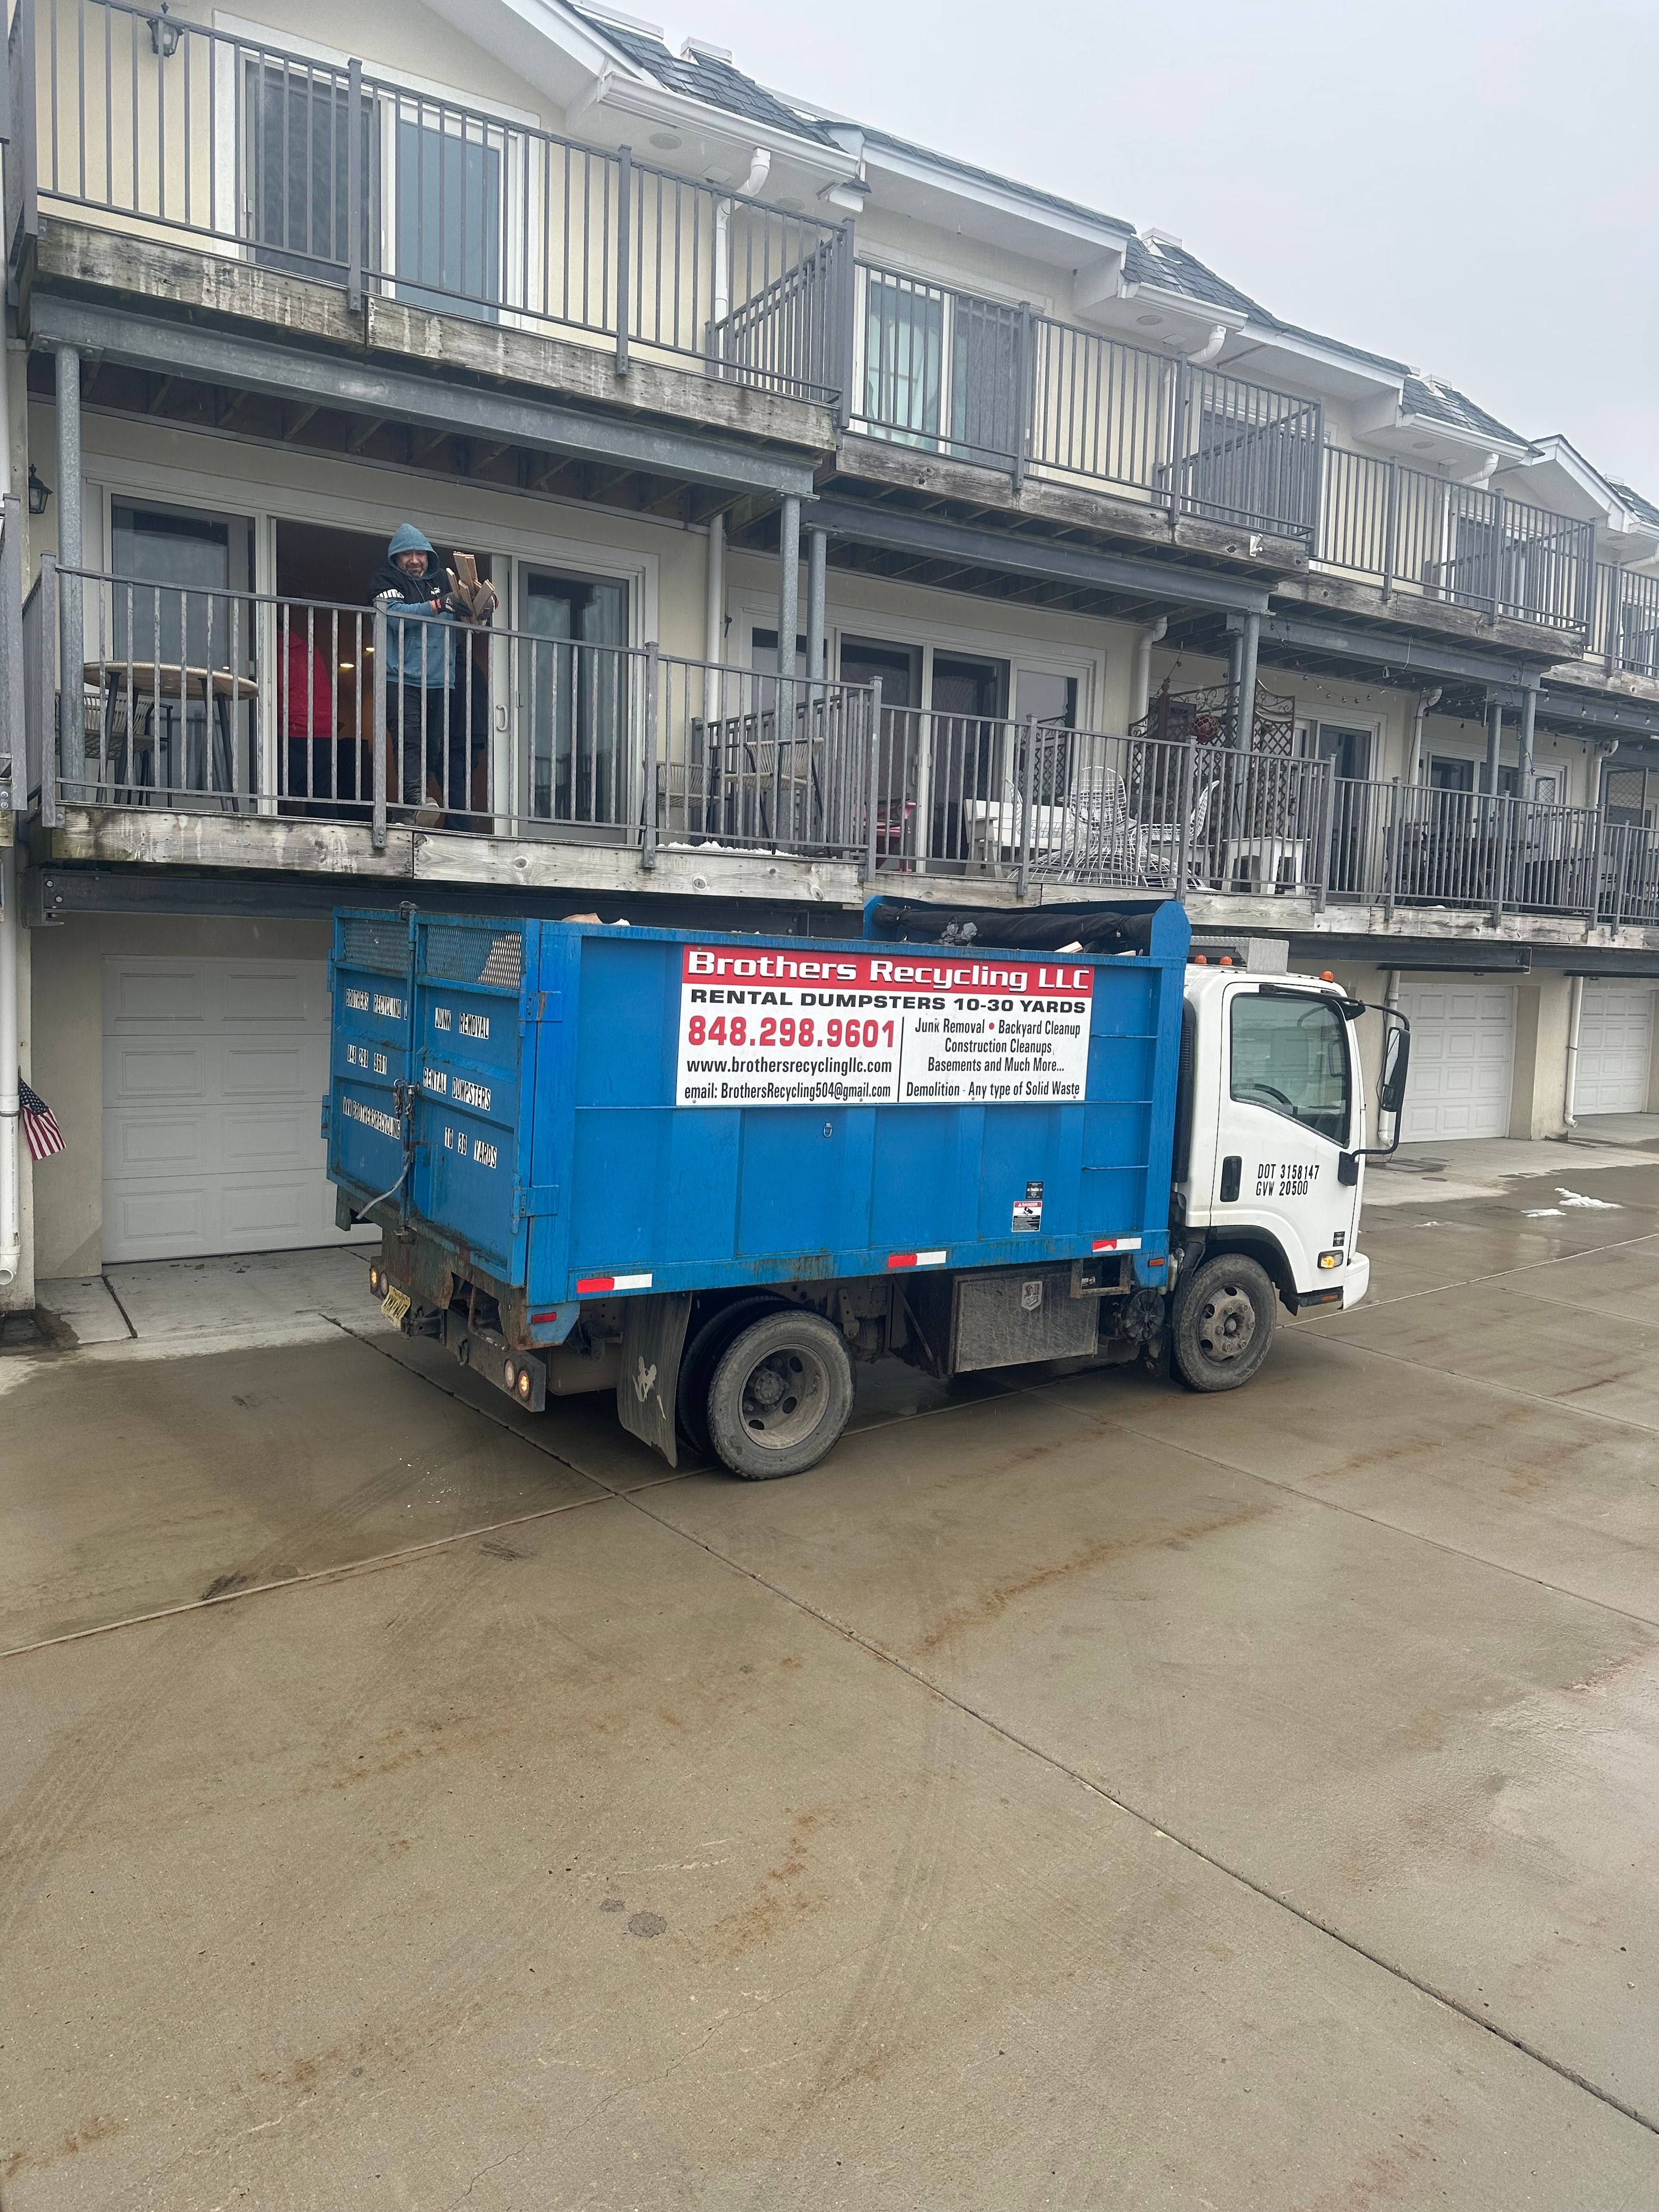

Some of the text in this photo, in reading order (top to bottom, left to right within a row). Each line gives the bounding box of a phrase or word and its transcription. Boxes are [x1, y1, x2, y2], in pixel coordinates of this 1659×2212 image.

[688, 951, 1090, 992] Brothers Recycling LLC
[346, 989, 369, 1011] BROTHERS
[691, 989, 1086, 1014] RENTAL DUMPSTERS 10-30 YARDS
[436, 1008, 489, 1039] JUNK REMOVAL
[688, 1015, 894, 1048] 848.298.9601
[915, 1018, 1081, 1039] Junk Removal Backyard Cleanup
[945, 1037, 1006, 1053] Construction
[348, 1045, 387, 1074] 848 298 9601
[687, 1057, 892, 1076] www.brothersrecyclingllc.com
[928, 1057, 1065, 1072] Basements and Much More...
[424, 1067, 491, 1110] RENTAL DUMPSTERS
[685, 1082, 891, 1102] email: BrothersRecycling504@gmail.com
[906, 1082, 959, 1097] Demolition
[968, 1082, 987, 1099] Any
[990, 1083, 1010, 1099] type
[1013, 1082, 1023, 1095] of
[1025, 1081, 1048, 1095] Solid
[1052, 1081, 1080, 1095] Waste
[446, 1128, 497, 1168] 10 30 YARDS
[1258, 1164, 1320, 1180] DOT 3158147
[1256, 1180, 1308, 1196] GVW 20500
